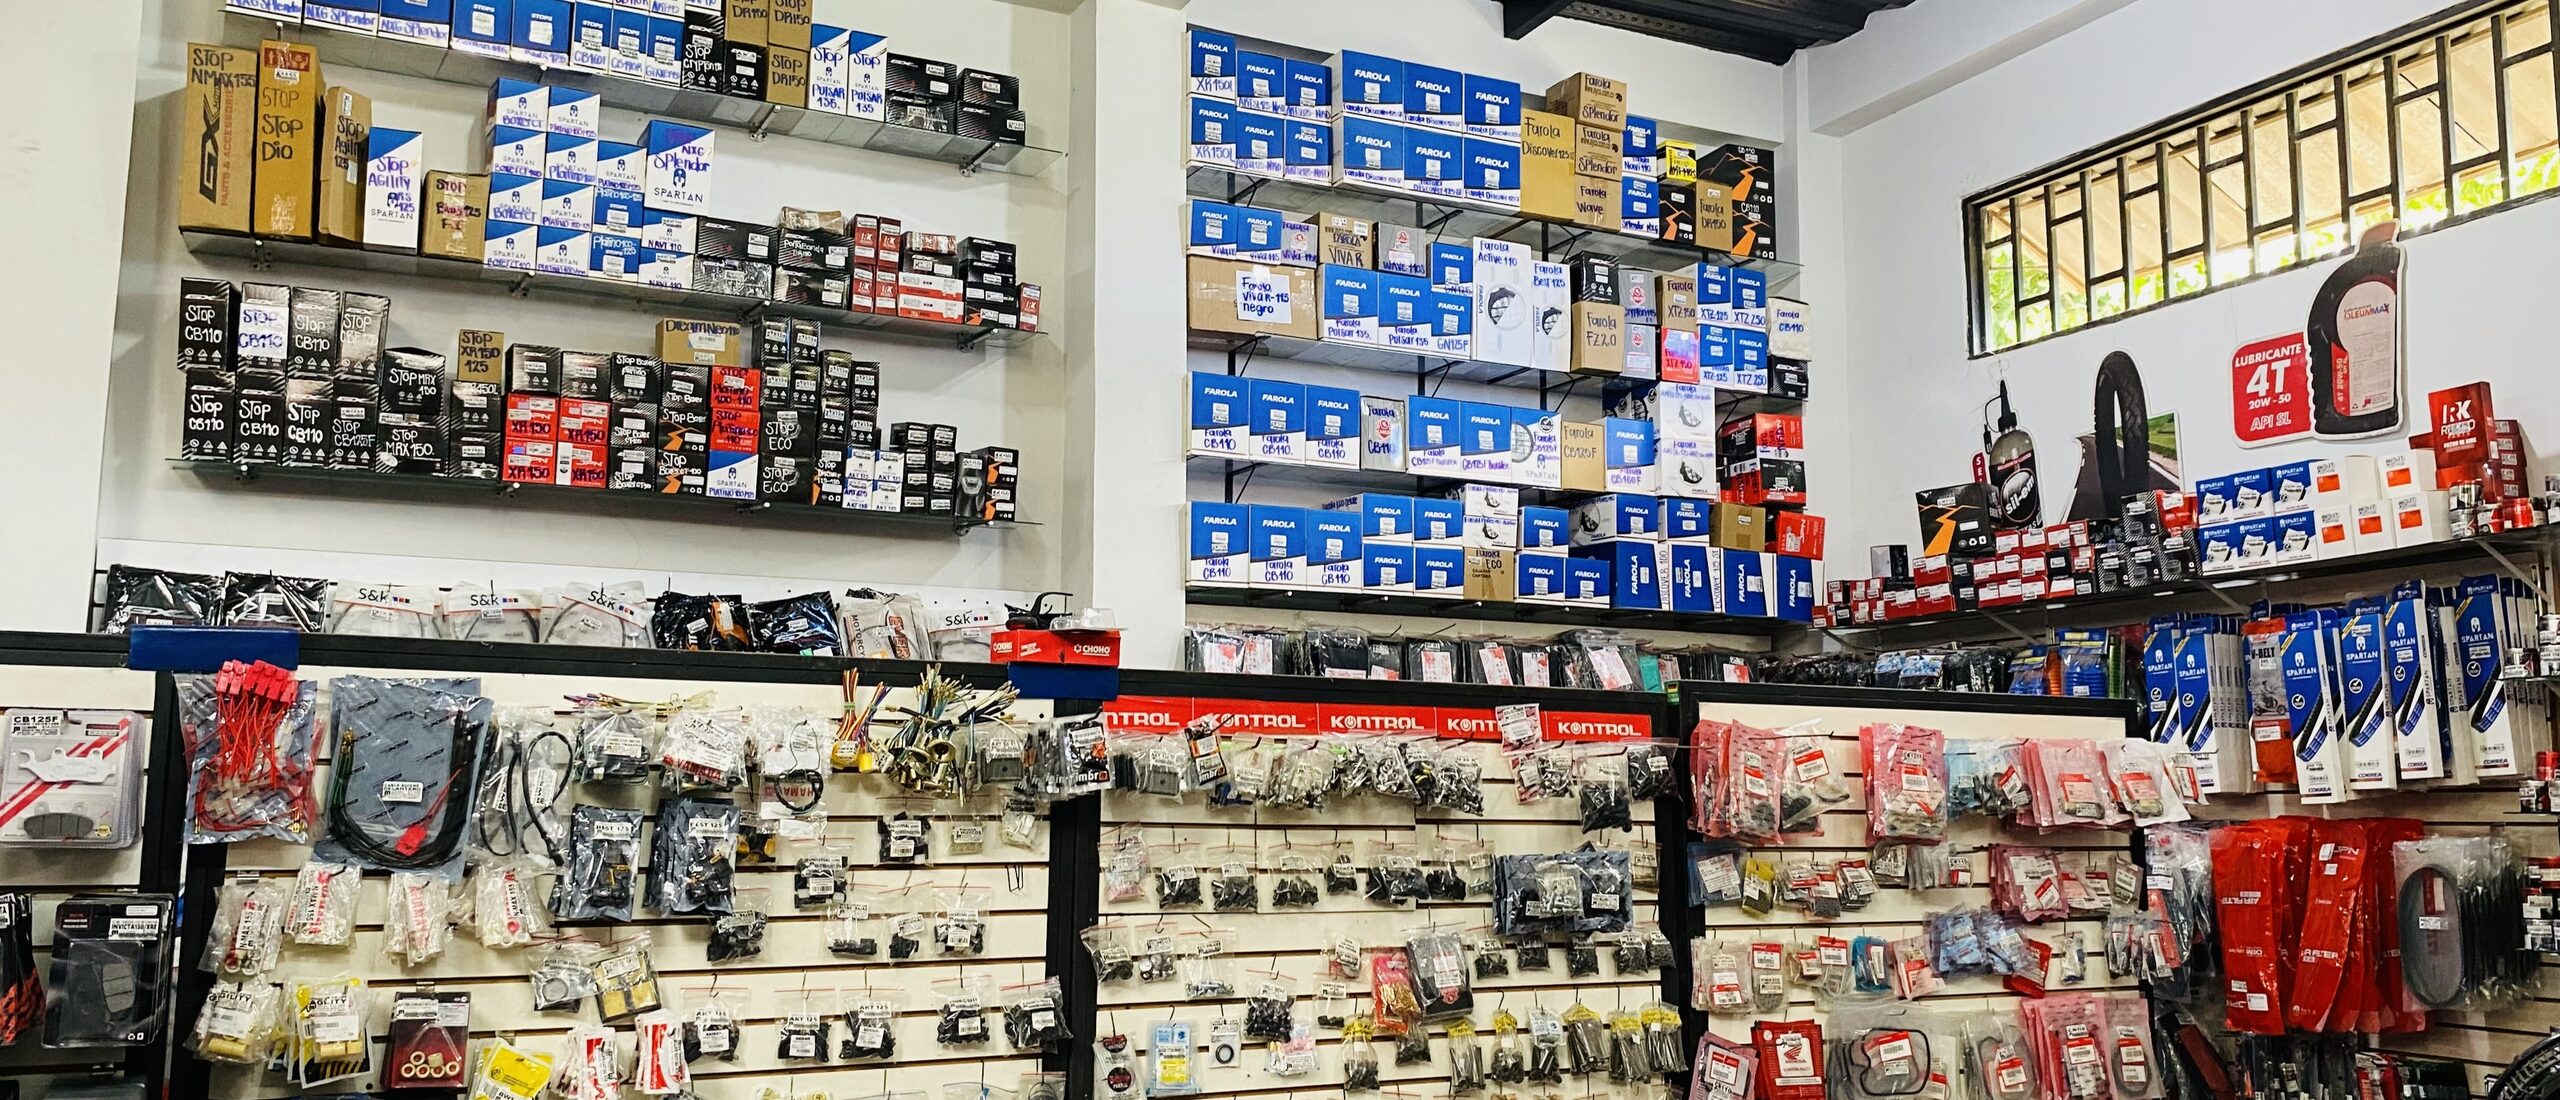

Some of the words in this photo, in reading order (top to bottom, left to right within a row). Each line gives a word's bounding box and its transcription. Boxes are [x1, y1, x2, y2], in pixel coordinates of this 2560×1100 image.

[1198, 41, 1228, 54] FAROLA
[1246, 65, 1275, 76] FAROLA
[1354, 68, 1391, 84] FAROLA
[1294, 73, 1323, 84] FAROLA
[1415, 80, 1451, 94] FAROLA
[1475, 91, 1510, 106] FAROLA
[1199, 109, 1229, 120] FAROLA
[1245, 126, 1274, 137] FAROLA
[1524, 116, 1561, 138] Farola
[1355, 135, 1392, 150] FAROLA
[1416, 146, 1451, 160] FAROLA
[1475, 155, 1509, 170] FAROLA
[654, 186, 704, 203] SPARTAN
[1580, 185, 1607, 198] Farola
[1628, 189, 1652, 199] FAROLA
[1576, 201, 1604, 215] Wave
[371, 209, 413, 220] SPARTAN
[1202, 211, 1228, 220] FAROLA
[1247, 218, 1273, 226] FAROLA
[1480, 240, 1509, 252] Farola
[1534, 263, 1563, 274] Farola
[1335, 279, 1367, 290] FAROLA
[1738, 277, 1760, 287] FAROLA
[1389, 287, 1421, 297] FAROLA
[1243, 303, 1274, 316] negro
[1438, 302, 1465, 312] FAROLA
[1587, 312, 1617, 328] Farola
[2235, 343, 2302, 368] LUBRICANTE
[2246, 359, 2291, 397] 4T
[1204, 386, 1238, 399] FAROLA
[1262, 393, 1295, 405] FAROLA
[1317, 399, 1349, 411] FAROLA
[2248, 399, 2271, 410] 20W
[2279, 393, 2292, 404] 50
[2250, 416, 2273, 432] API
[2276, 412, 2292, 426] SL
[1616, 432, 1645, 440] FAROLA
[769, 437, 792, 450] ECO
[1525, 470, 1558, 480] SPARTAN
[763, 481, 789, 494] ECO
[2006, 475, 2034, 514] sil-em
[1203, 516, 1237, 527] FAROLA
[1262, 519, 1296, 530] FAROLA
[1318, 523, 1351, 534] FAROLA
[2390, 637, 2416, 648] SPARTAN
[2461, 632, 2494, 643] SPARTAN
[1083, 644, 1110, 654] CHOHO
[2346, 651, 2378, 661] SPARTAN
[2148, 662, 2173, 672] SPARTAN
[2179, 668, 2206, 677] SPARTAN
[2286, 667, 2317, 677] SPARTAN
[1331, 715, 1424, 730] KONTROL
[1448, 718, 1500, 732] KONT
[1558, 721, 1642, 736] KONTROL
